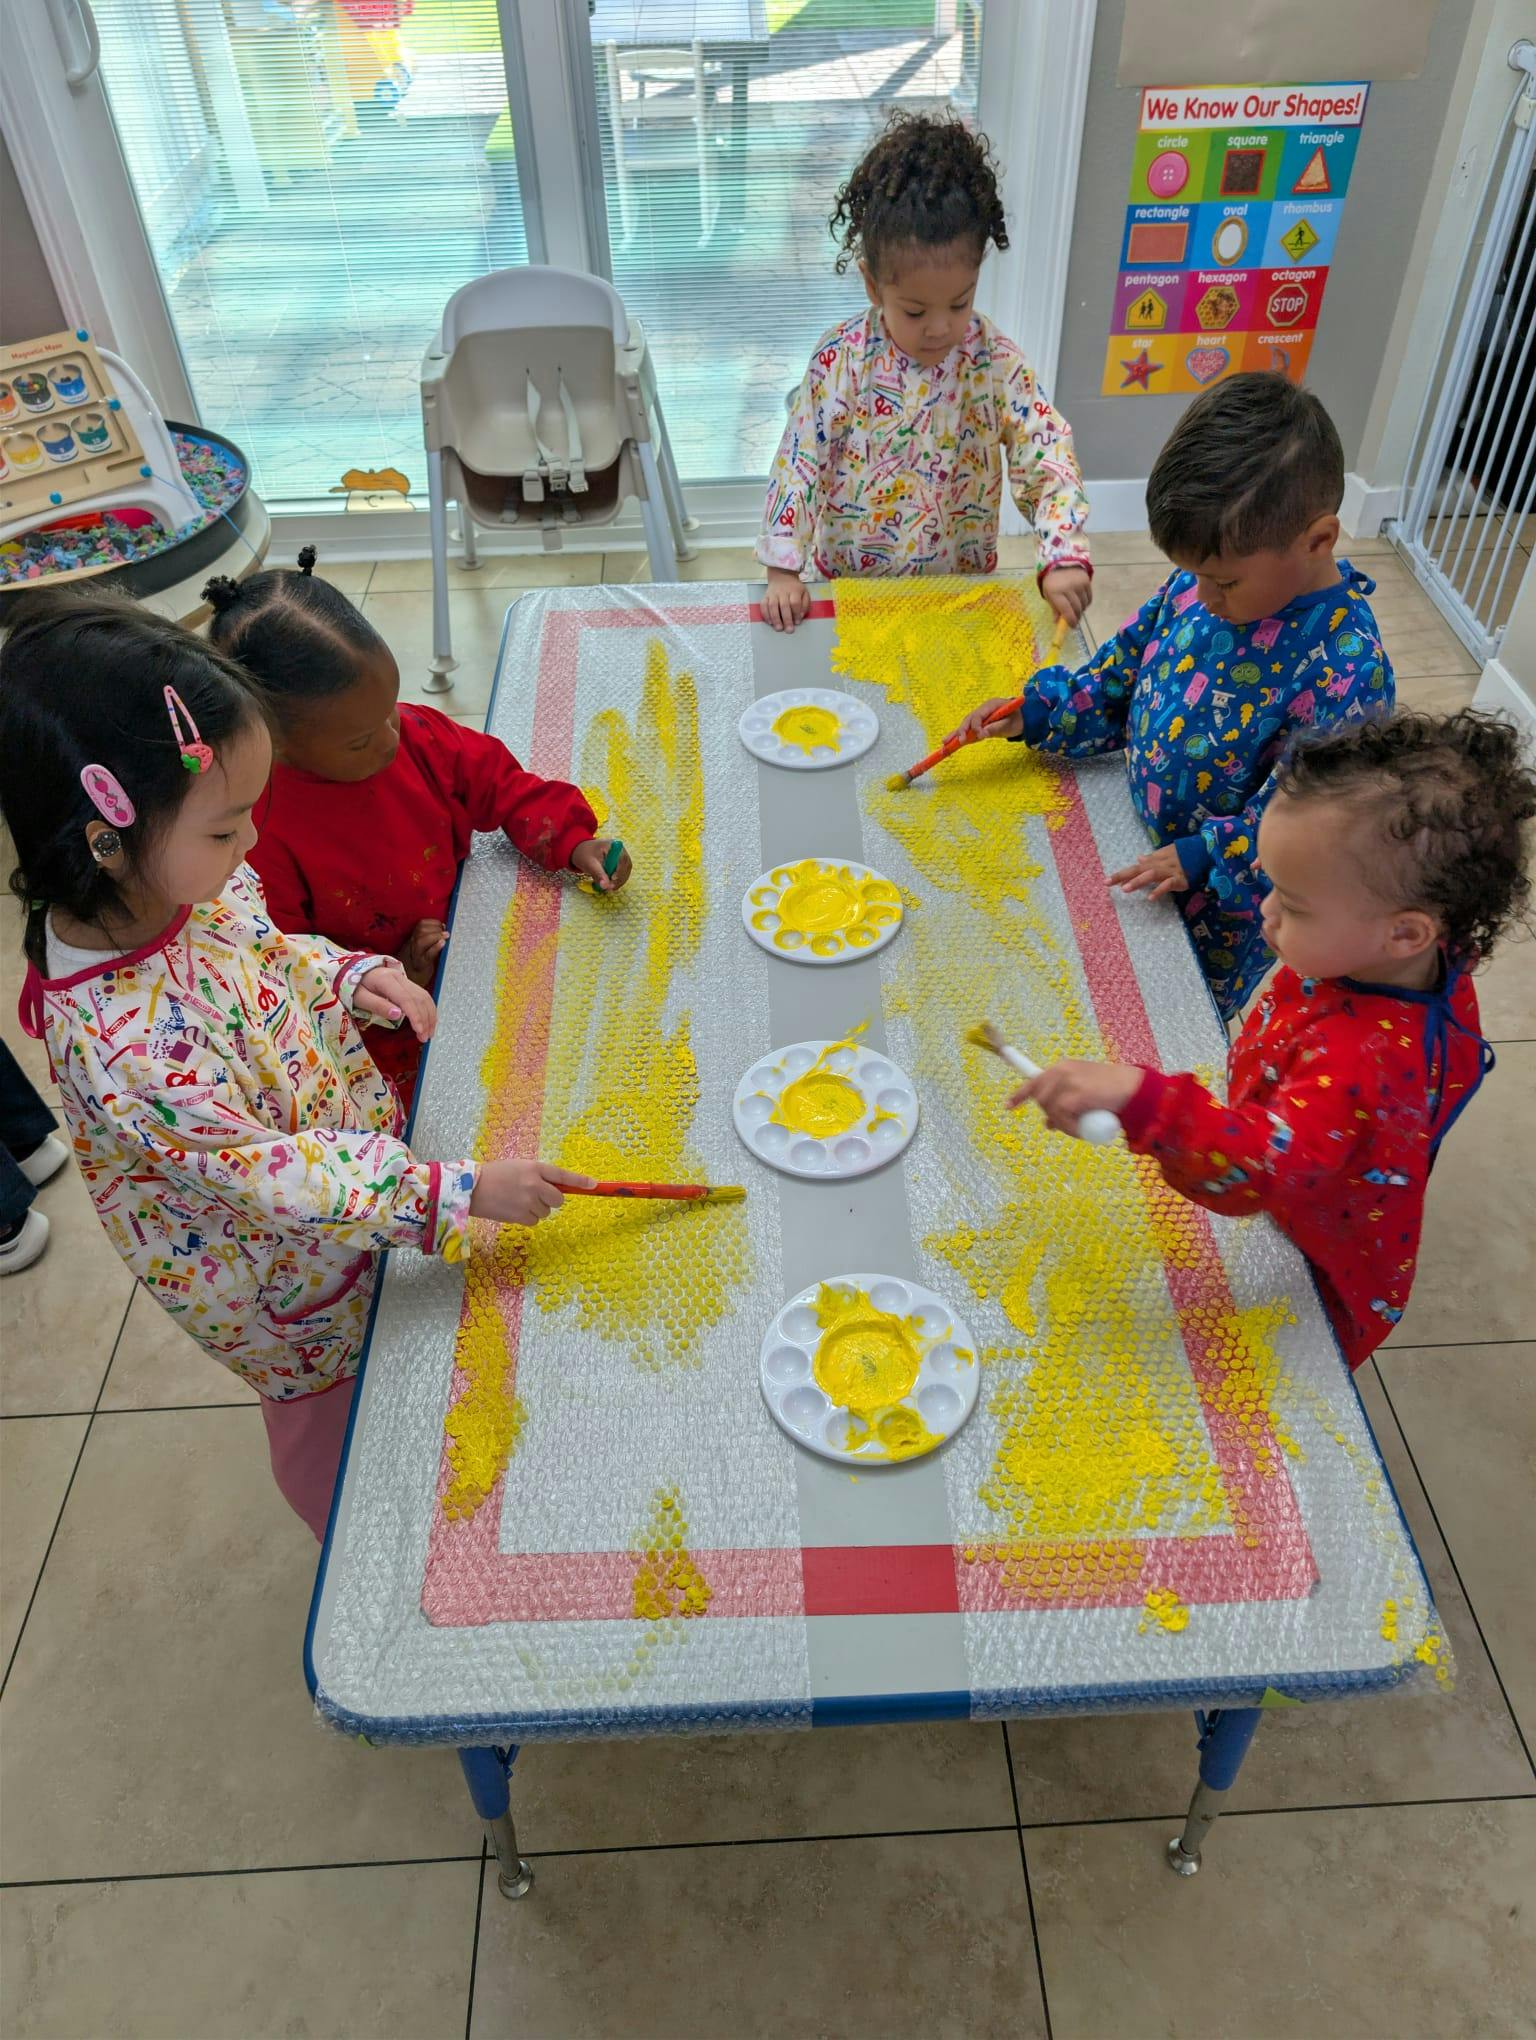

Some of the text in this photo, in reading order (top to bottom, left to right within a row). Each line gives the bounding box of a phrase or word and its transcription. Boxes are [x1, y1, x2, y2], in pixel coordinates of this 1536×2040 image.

[1147, 92, 1361, 122] We Know Our Shapes!
[1157, 136, 1189, 149] circle
[1227, 134, 1268, 149] square
[1299, 131, 1345, 146] triangle
[1135, 205, 1189, 220] rectangle
[1223, 204, 1248, 217] oval
[1283, 201, 1332, 214] rhombus
[1125, 274, 1179, 288] pentagon
[1198, 271, 1247, 285] hexagon
[1271, 269, 1316, 282] octagon
[1271, 297, 1304, 313] STOP
[1132, 337, 1153, 349] star
[1196, 335, 1227, 346] heart
[1257, 333, 1304, 345] crescent
